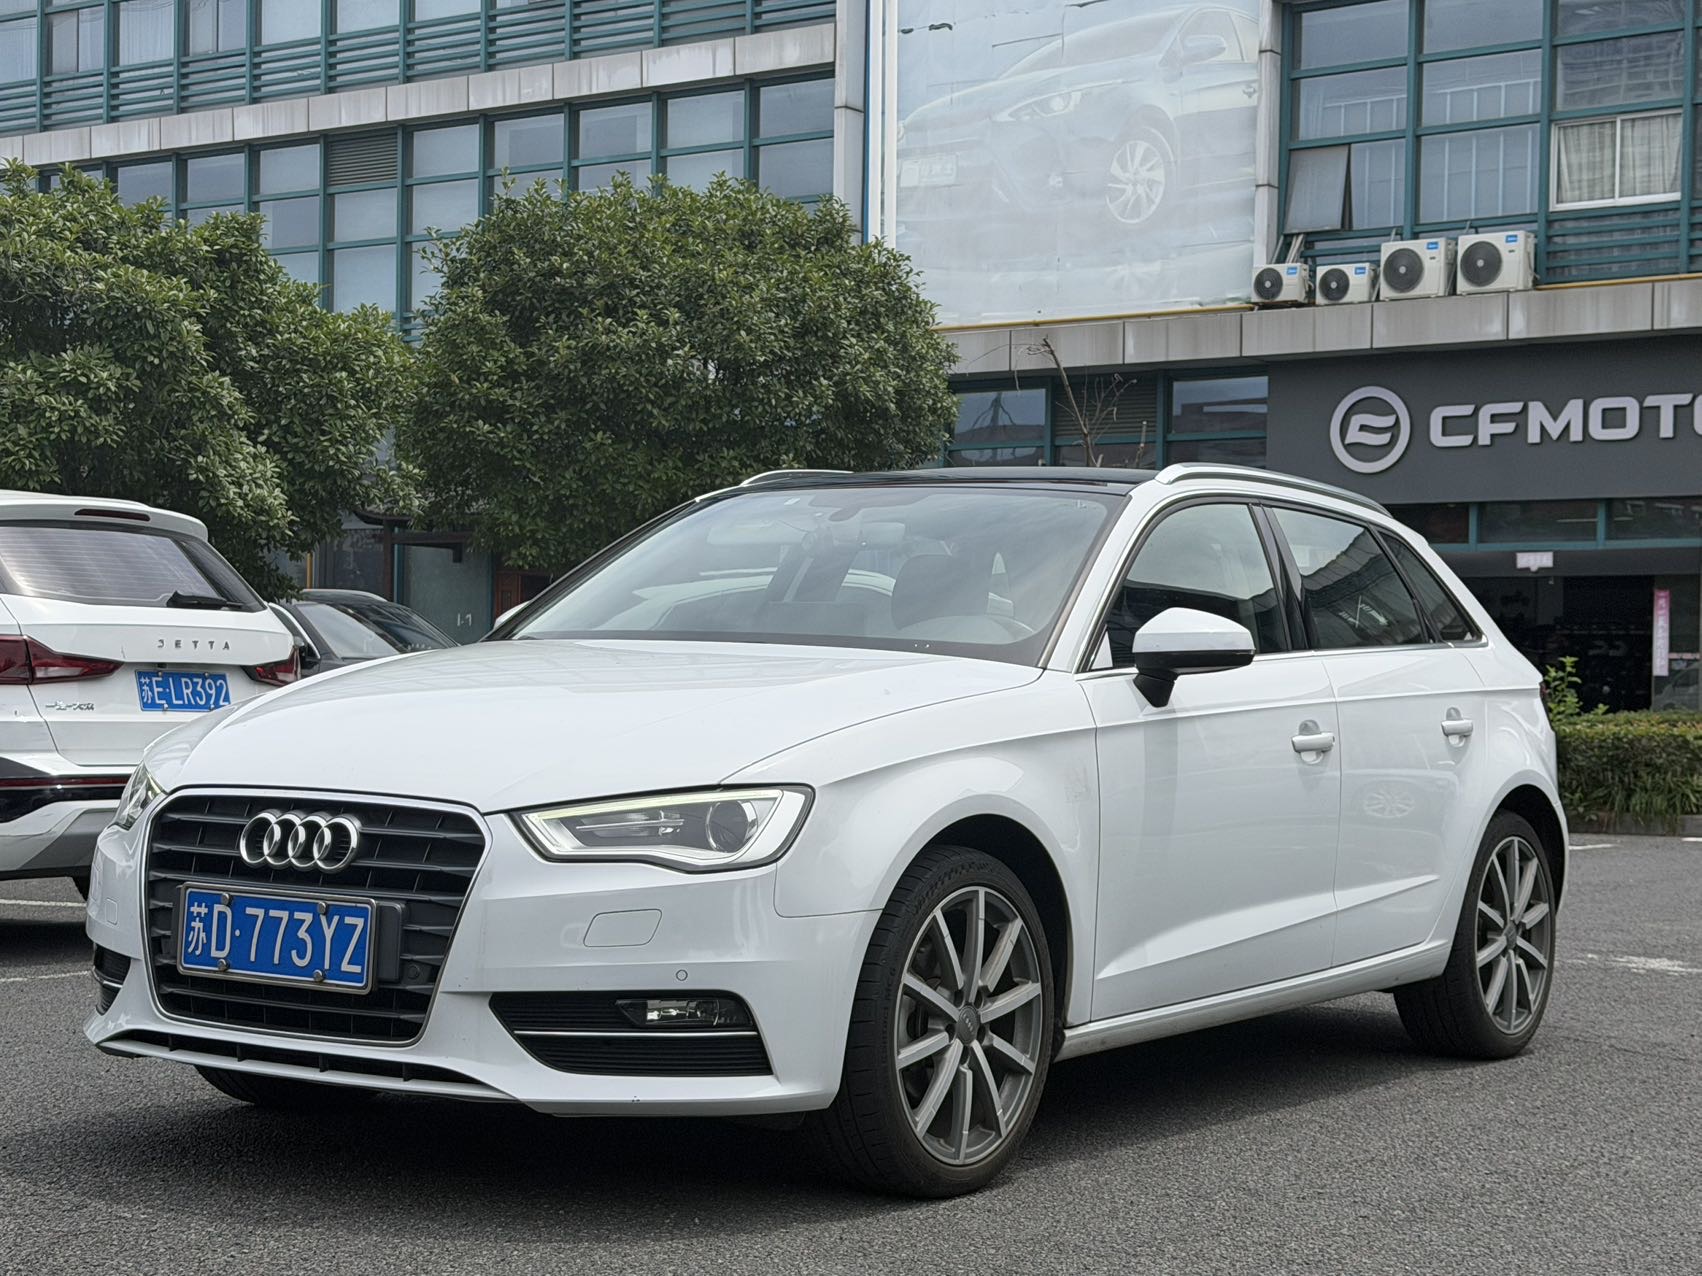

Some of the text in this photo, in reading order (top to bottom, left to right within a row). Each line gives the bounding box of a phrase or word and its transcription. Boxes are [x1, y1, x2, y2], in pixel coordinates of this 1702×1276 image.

[1430, 393, 1702, 447] CFMOT
[157, 638, 230, 650] JETTA
[187, 901, 365, 973] 苏D·773YZ
